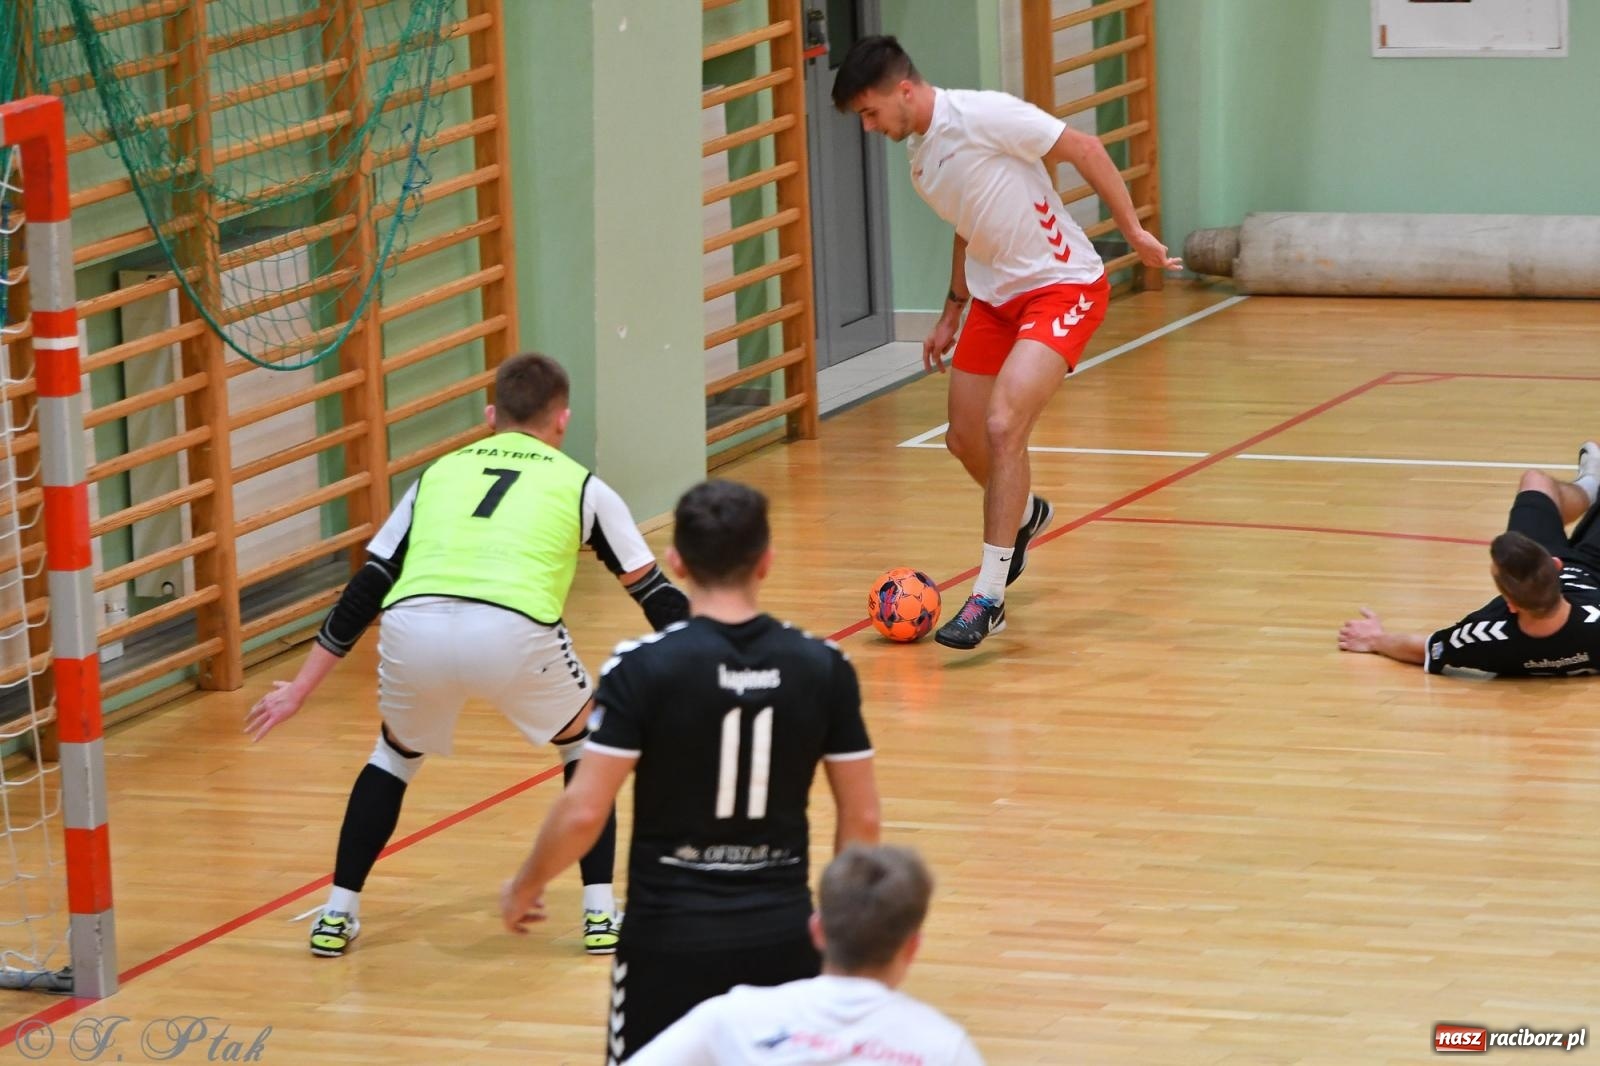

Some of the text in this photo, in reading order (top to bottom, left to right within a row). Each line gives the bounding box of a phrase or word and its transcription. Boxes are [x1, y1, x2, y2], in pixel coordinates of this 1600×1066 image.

[475, 448, 555, 463] PATRICK
[471, 467, 522, 519] 7
[715, 706, 774, 819] 11
